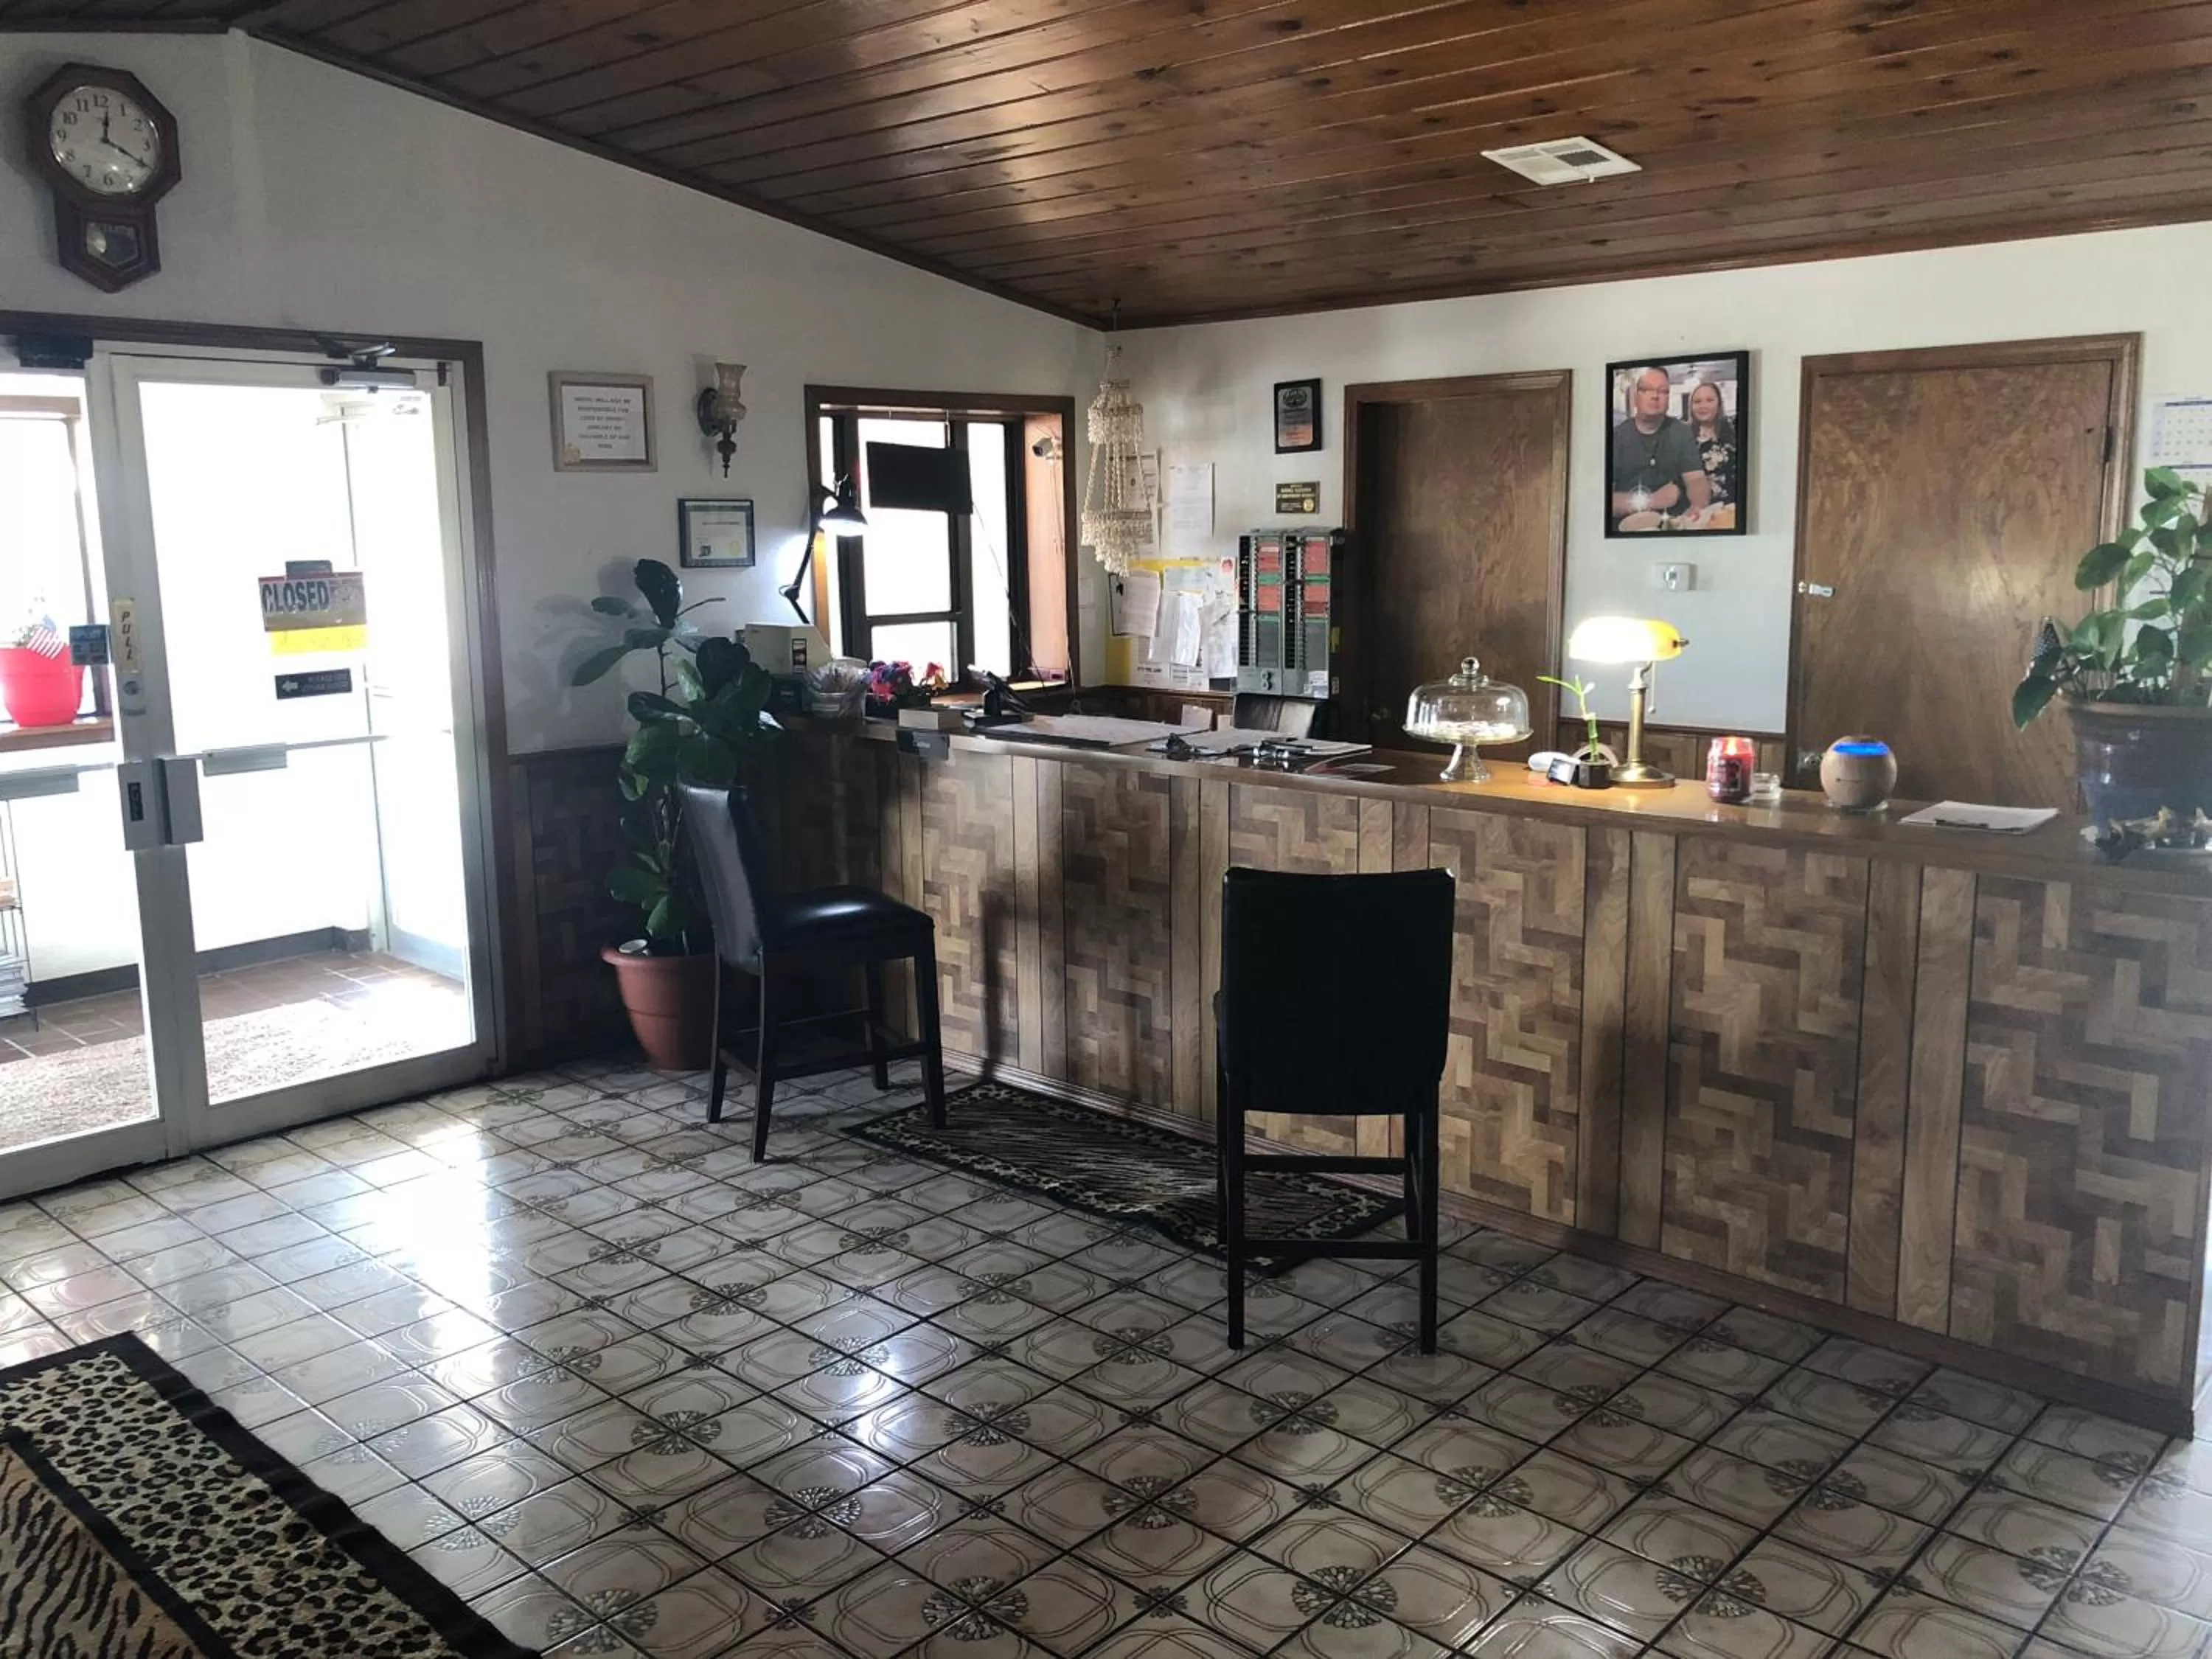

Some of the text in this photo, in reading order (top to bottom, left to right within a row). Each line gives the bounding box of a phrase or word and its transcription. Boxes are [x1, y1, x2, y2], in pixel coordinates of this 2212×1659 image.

[76, 98, 88, 112] 11
[93, 94, 109, 107] 12
[120, 103, 126, 116] 1
[57, 128, 66, 142] 9
[83, 164, 91, 177] 7
[261, 580, 330, 613] CLOSED
[121, 611, 133, 660] PULL
